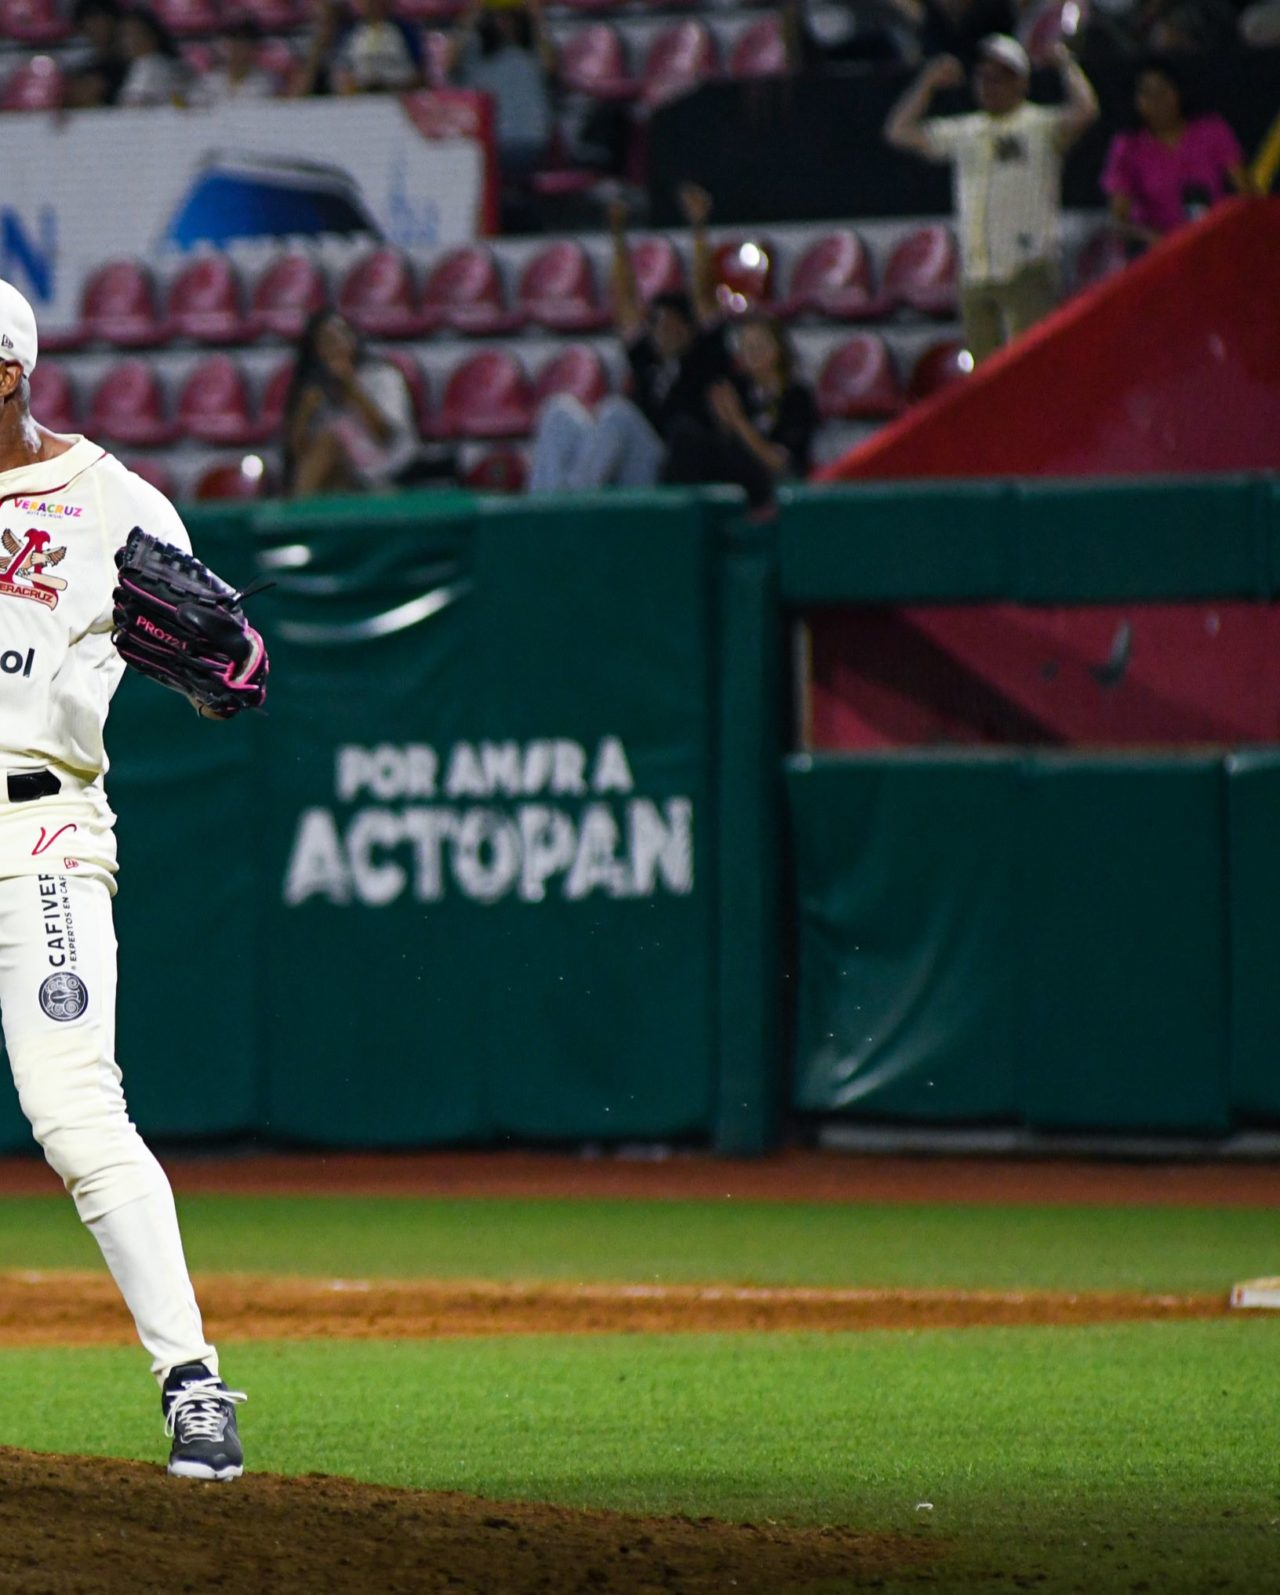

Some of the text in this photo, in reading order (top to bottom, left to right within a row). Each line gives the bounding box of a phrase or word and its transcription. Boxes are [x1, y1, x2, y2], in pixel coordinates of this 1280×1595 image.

[14, 498, 82, 517] VERACRUZ
[335, 741, 438, 802] POR
[591, 734, 634, 795] A
[282, 796, 694, 907] ACTOPAN
[62, 896, 71, 910] EN
[64, 912, 77, 962] EXPERTOS
